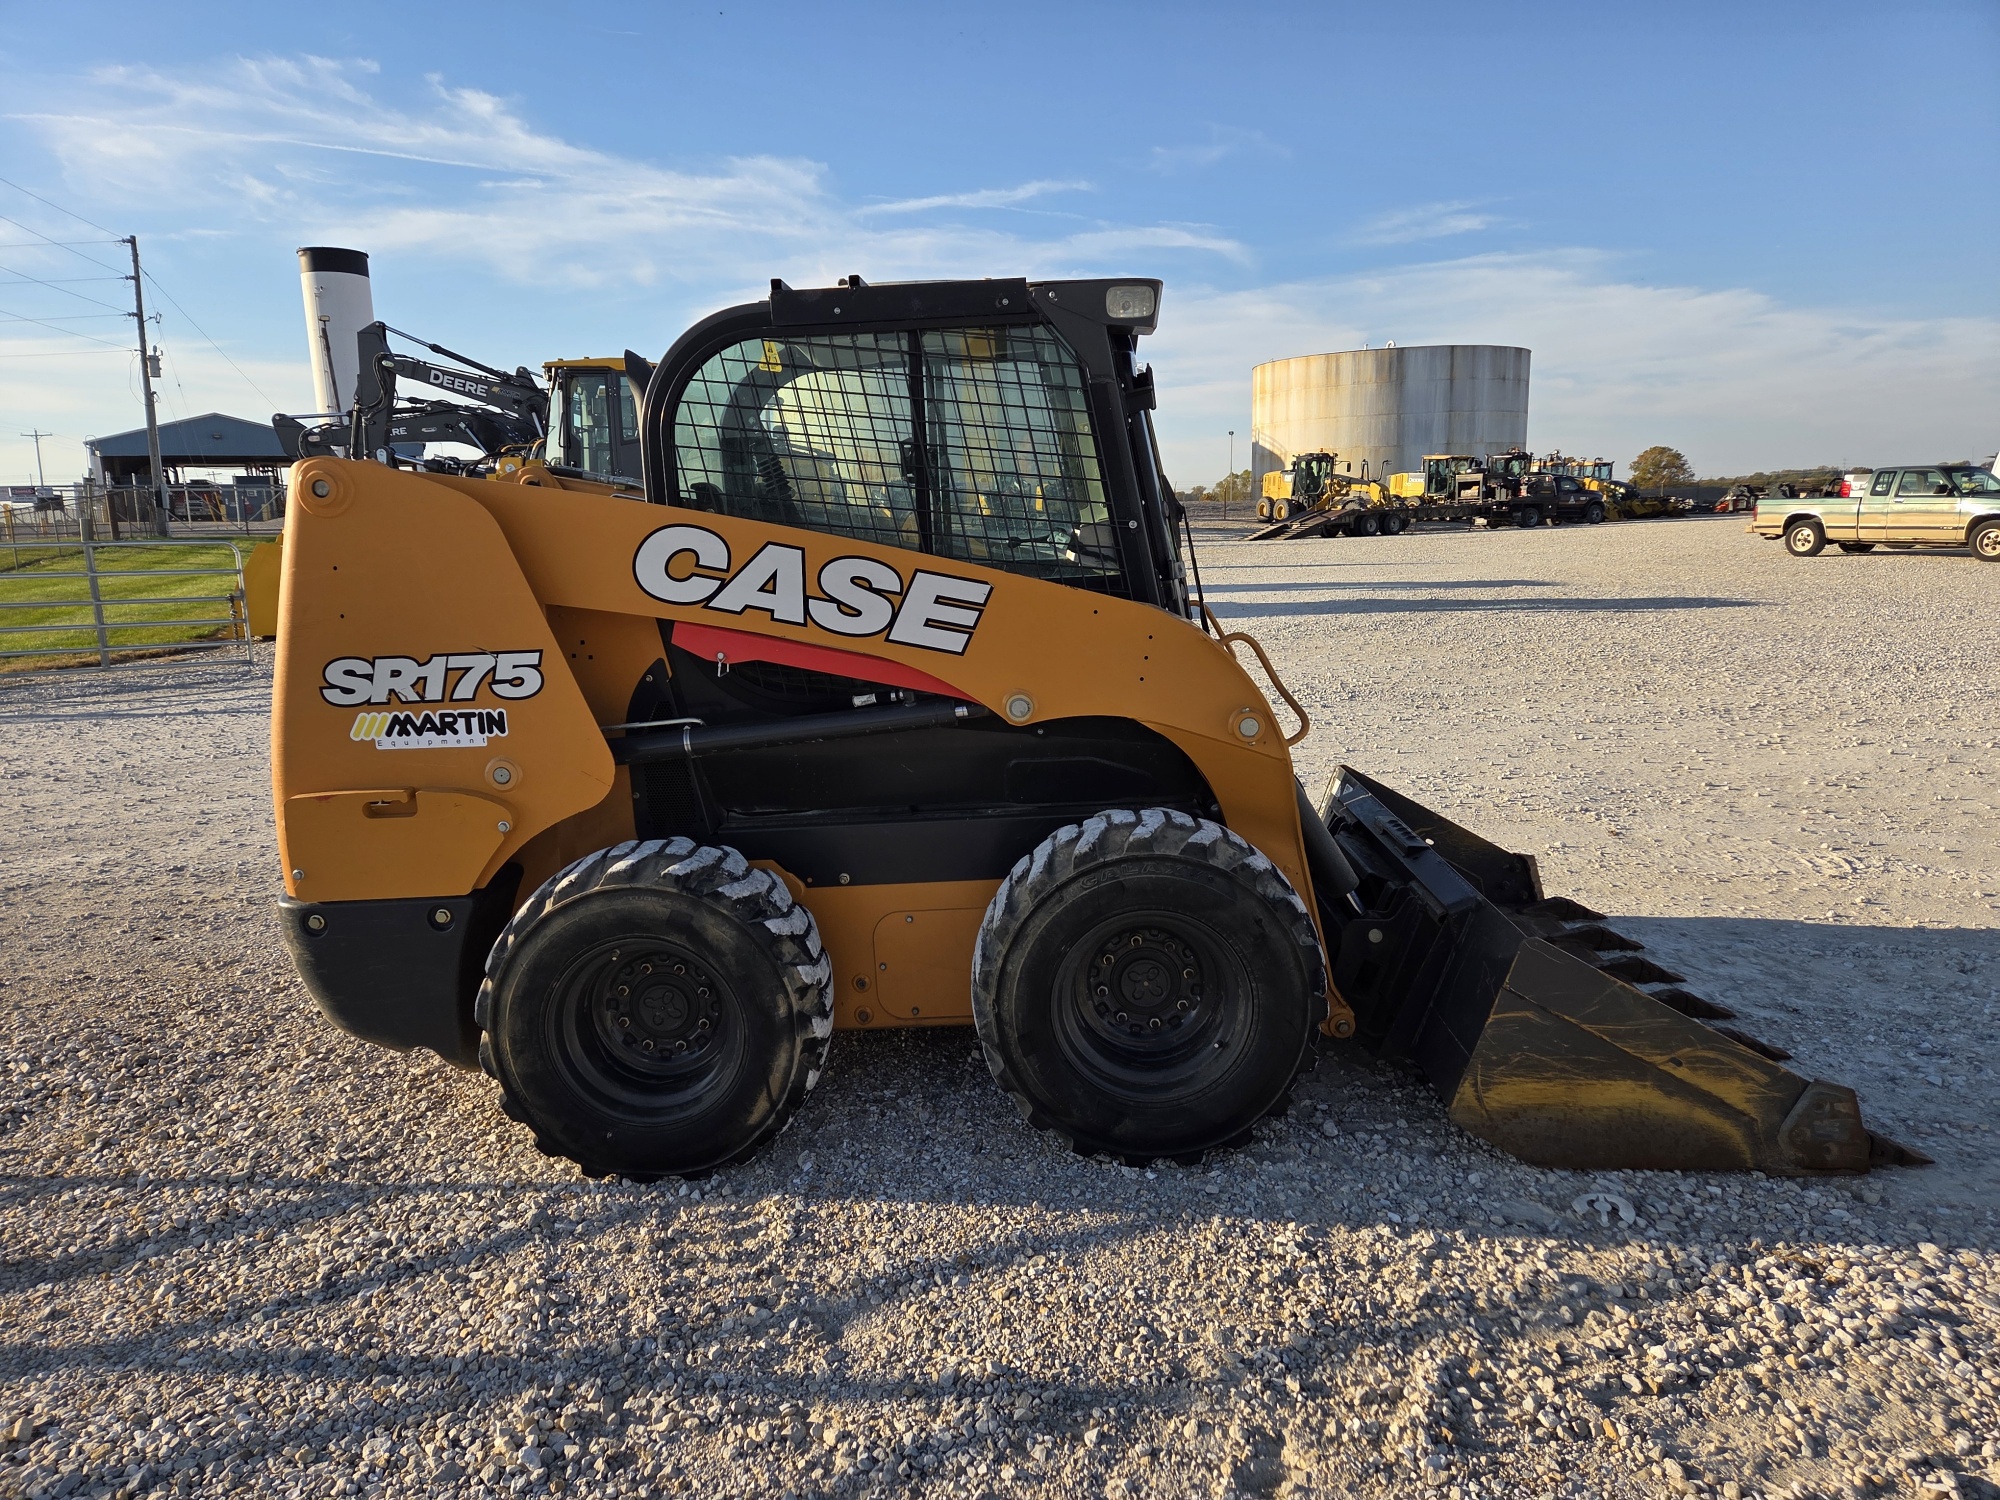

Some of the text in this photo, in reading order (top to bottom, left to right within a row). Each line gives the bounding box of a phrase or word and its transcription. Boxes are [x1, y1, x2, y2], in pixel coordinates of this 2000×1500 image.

[430, 369, 488, 397] DEERE
[390, 427, 407, 436] RE
[632, 523, 994, 656] CASE
[319, 649, 545, 707] SR175
[385, 711, 507, 738] MARTIN
[377, 737, 487, 747] Equipment
